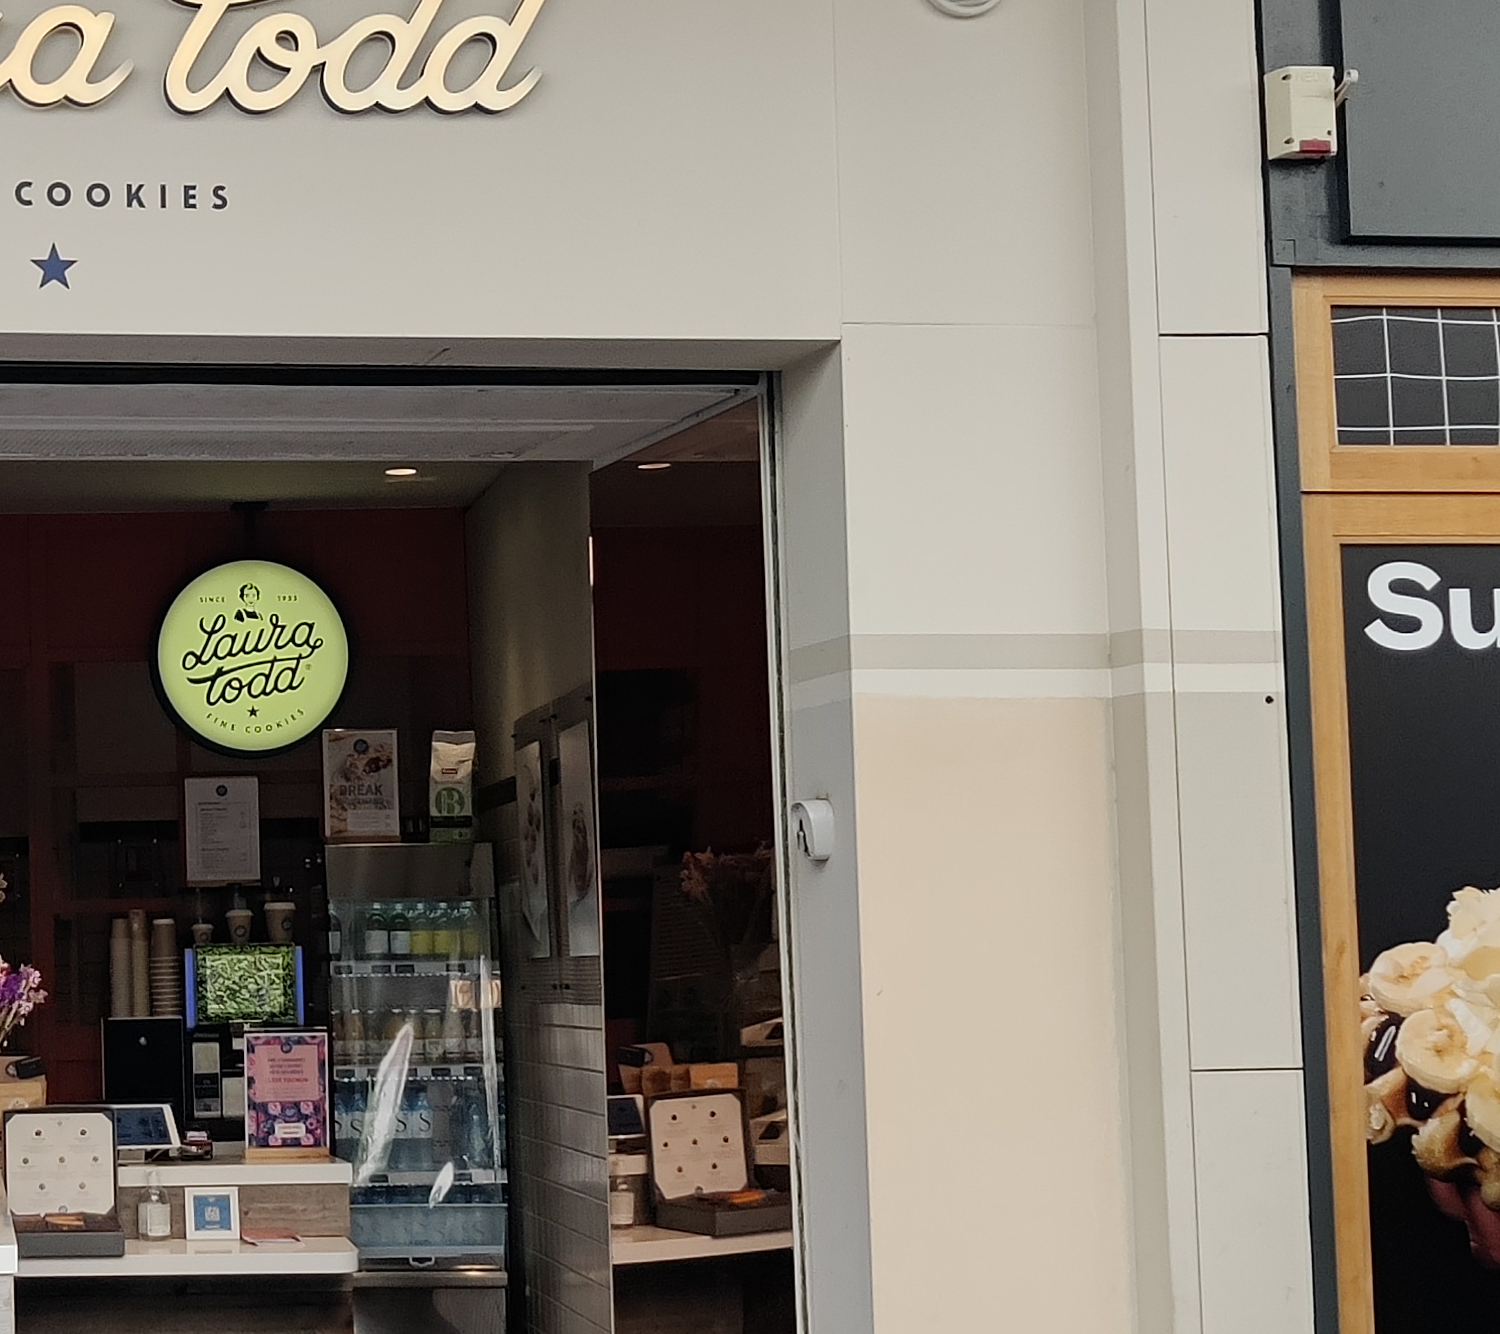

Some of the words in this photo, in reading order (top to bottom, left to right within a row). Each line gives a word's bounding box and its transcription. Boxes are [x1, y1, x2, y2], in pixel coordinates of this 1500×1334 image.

[14, 180, 229, 210] COOKIES
[199, 596, 226, 604] SINCE
[181, 613, 325, 671] Laura
[186, 652, 306, 707] todd
[205, 713, 237, 732] FINE
[245, 708, 305, 734] COOKIES
